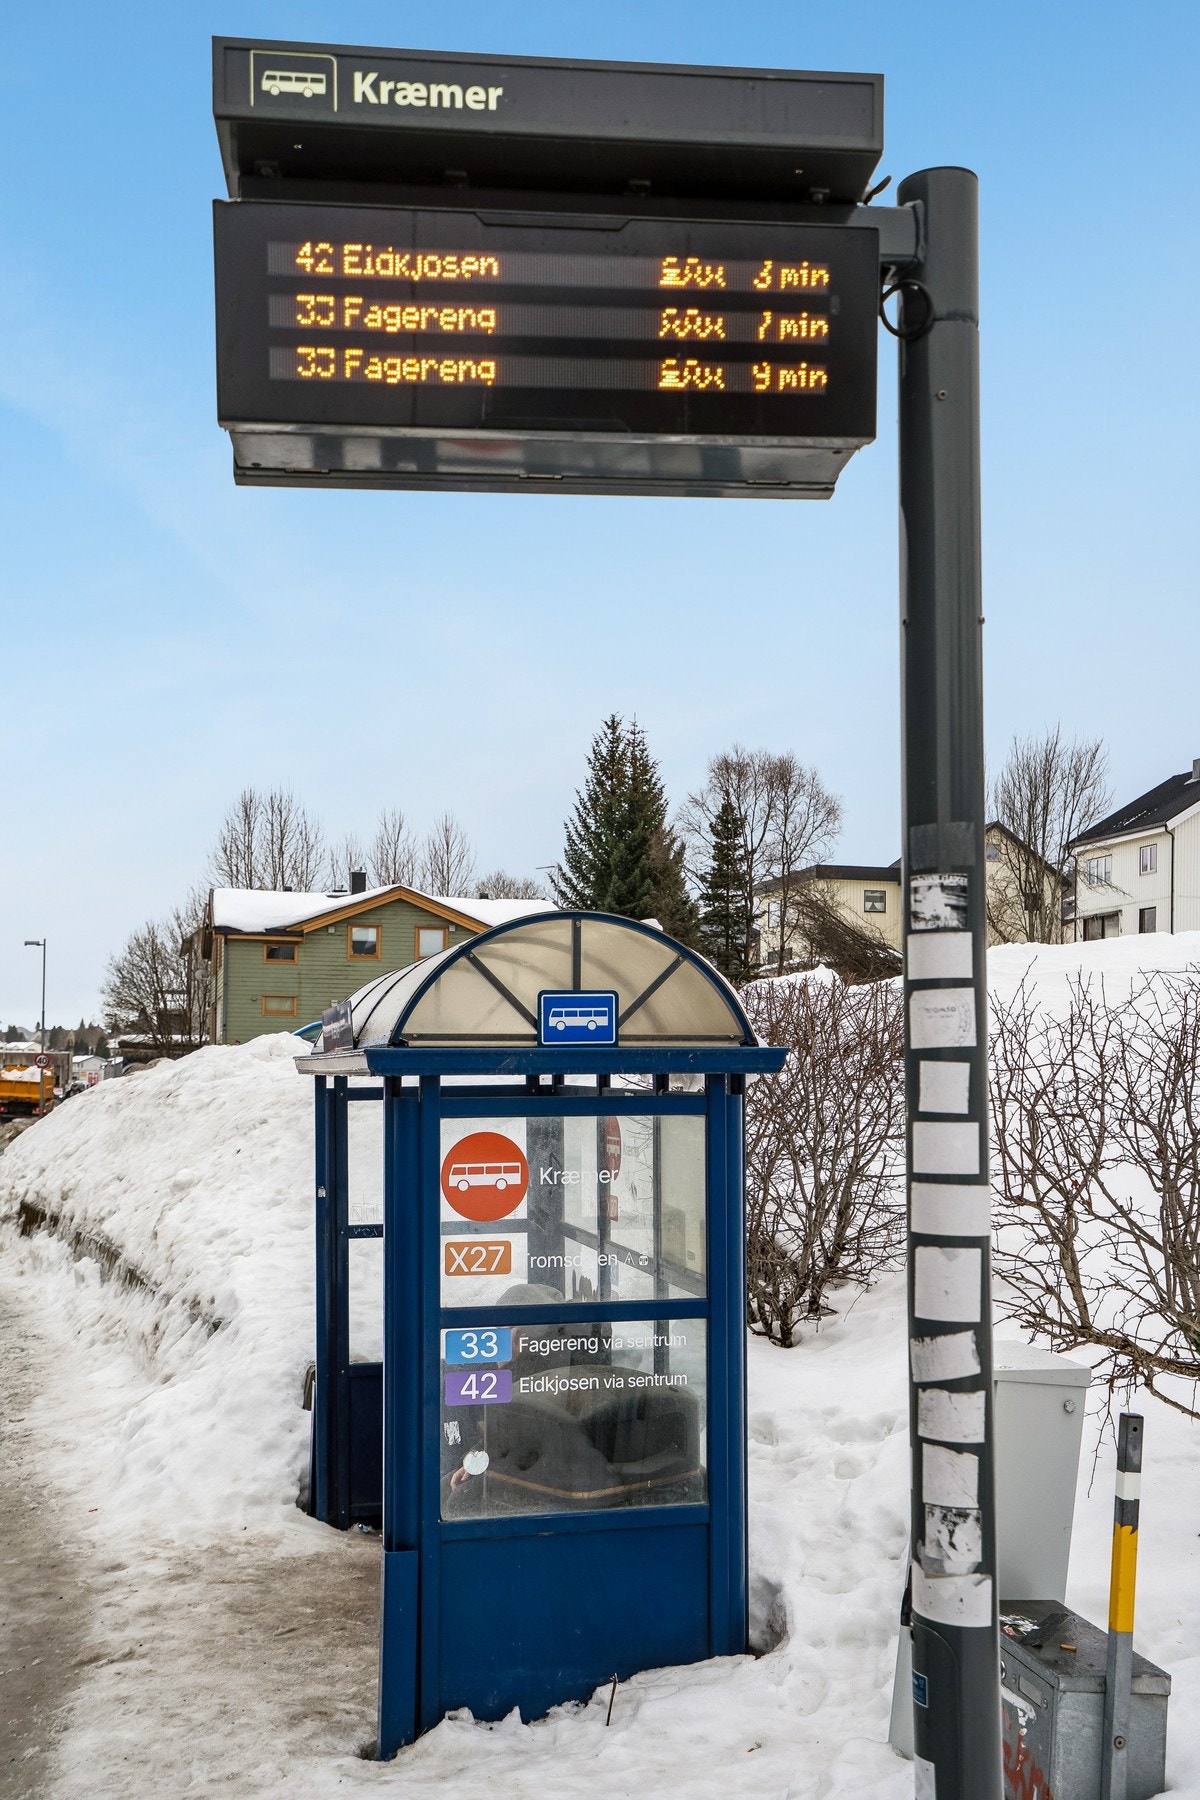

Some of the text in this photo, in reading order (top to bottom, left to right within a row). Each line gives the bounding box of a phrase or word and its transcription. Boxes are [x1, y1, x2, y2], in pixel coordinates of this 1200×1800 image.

[353, 71, 503, 111] Kræmer
[296, 242, 830, 290] 42 Eidkjosen 3 min
[296, 294, 335, 326] 33
[344, 296, 496, 335] Fagereng
[780, 312, 829, 340] min
[296, 347, 335, 378] 33
[344, 349, 496, 387] Fagereng
[779, 362, 828, 391] min
[37, 1057, 47, 1065] 40
[449, 1246, 505, 1273] X27
[460, 1331, 687, 1359] 33 Fagereng via sentrum
[460, 1372, 688, 1400] 42 Eidkjosen via sentrum
